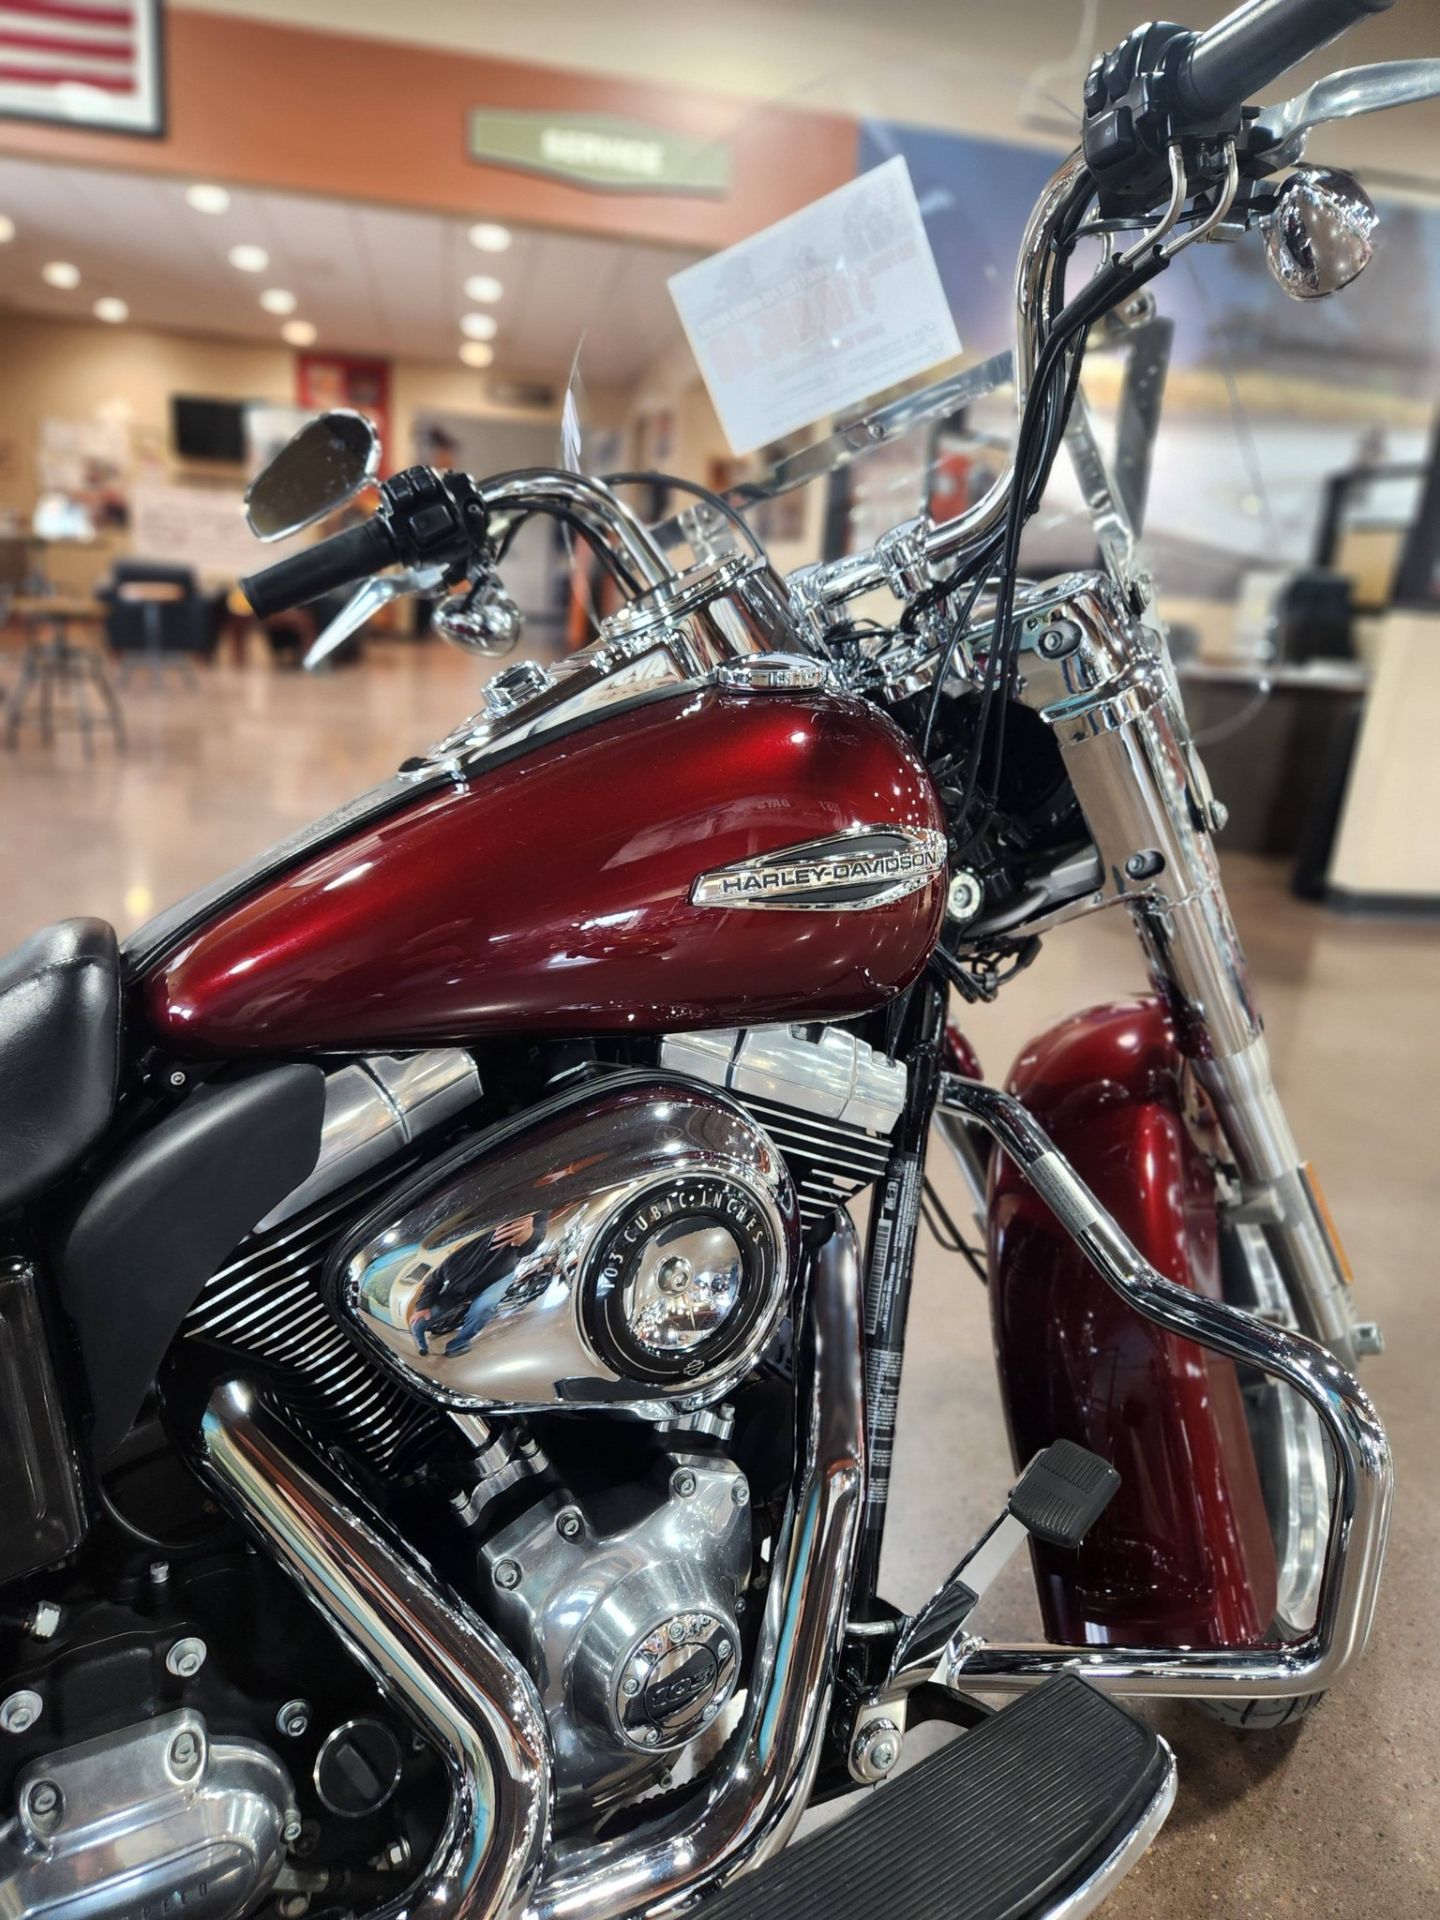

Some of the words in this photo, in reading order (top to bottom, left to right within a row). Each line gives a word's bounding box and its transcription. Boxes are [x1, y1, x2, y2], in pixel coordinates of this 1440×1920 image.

[723, 851, 937, 893] HARLEY-DAVIDSON
[601, 1253, 624, 1289] 103
[624, 1193, 688, 1243] CUBIC
[701, 1190, 764, 1244] INCHES
